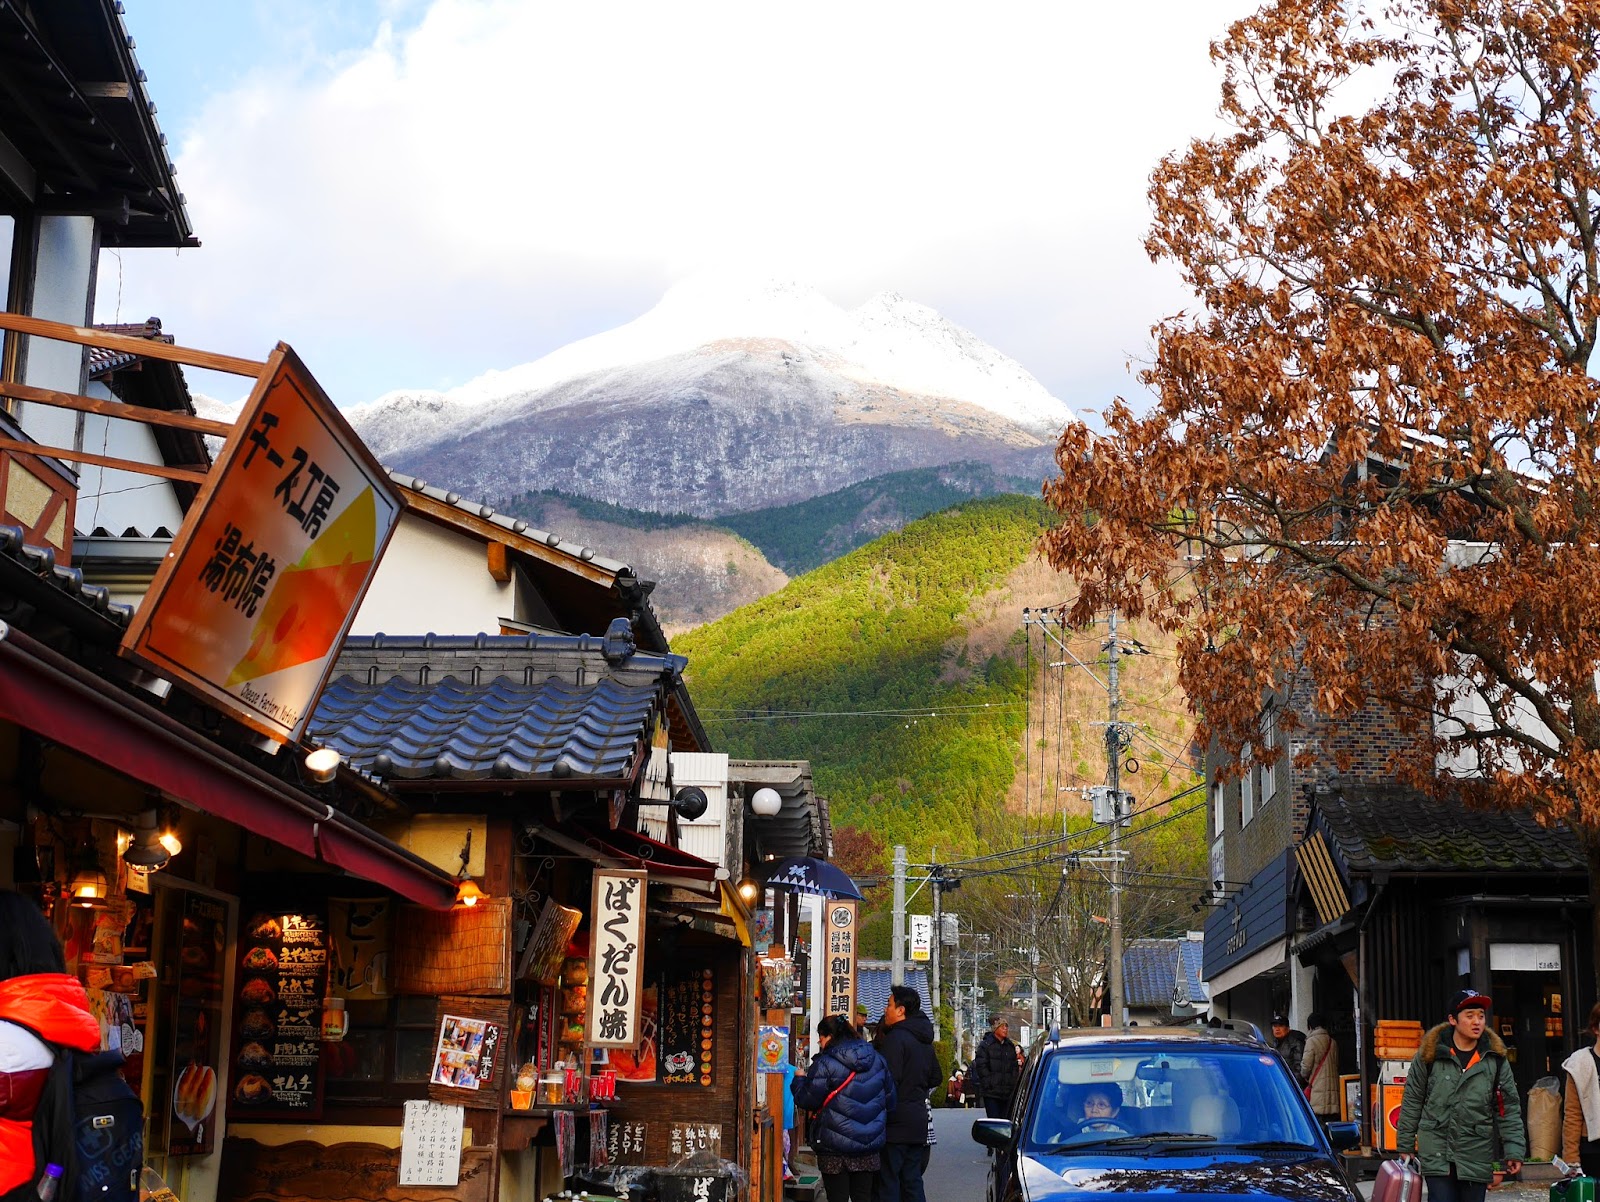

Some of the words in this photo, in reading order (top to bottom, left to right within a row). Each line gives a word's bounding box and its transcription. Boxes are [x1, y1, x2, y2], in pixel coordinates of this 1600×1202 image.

[242, 411, 341, 540] チーズ工房
[200, 521, 276, 618] 湯布院
[240, 682, 260, 704] Cheese
[258, 693, 281, 719] Factory
[832, 931, 840, 953] 醤油
[842, 931, 851, 953] 味噌
[914, 923, 928, 945] やどや
[280, 947, 326, 962] ネギ塩マヨ
[599, 878, 639, 1040] ばくだん焼
[831, 957, 850, 1019] 創作調
[278, 1009, 313, 1025] チーズ
[273, 1074, 312, 1090] キムチ
[449, 1127, 457, 1159] お客様へ
[608, 1124, 620, 1163] プラスチック
[622, 1125, 632, 1154] ストロー
[633, 1126, 644, 1152] ビニール
[671, 1128, 682, 1154] 空箱
[698, 1128, 707, 1149] はし
[79, 1160, 110, 1192] WISS
